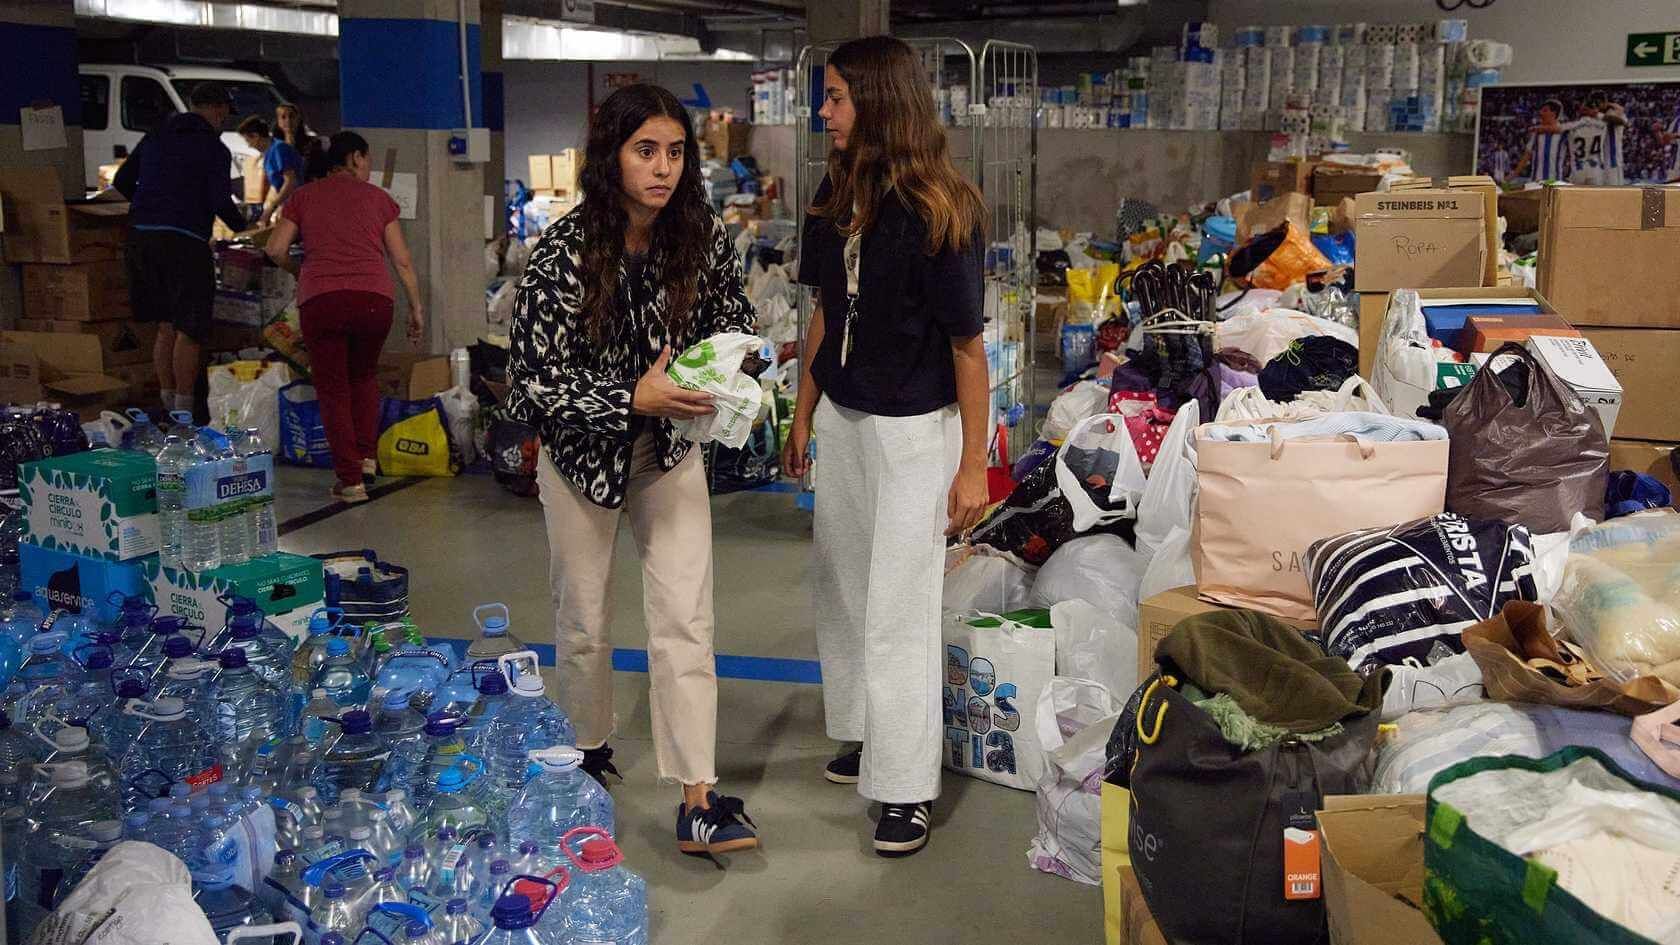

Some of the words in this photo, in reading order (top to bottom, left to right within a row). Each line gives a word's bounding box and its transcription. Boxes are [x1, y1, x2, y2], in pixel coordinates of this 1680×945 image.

[1574, 134, 1603, 158] 34
[1377, 201, 1434, 211] STEINBEIS
[48, 493, 74, 507] CIERRA
[35, 585, 95, 608] aquaservice
[170, 593, 199, 608] CIERRA
[1287, 873, 1319, 882] ORANGE
